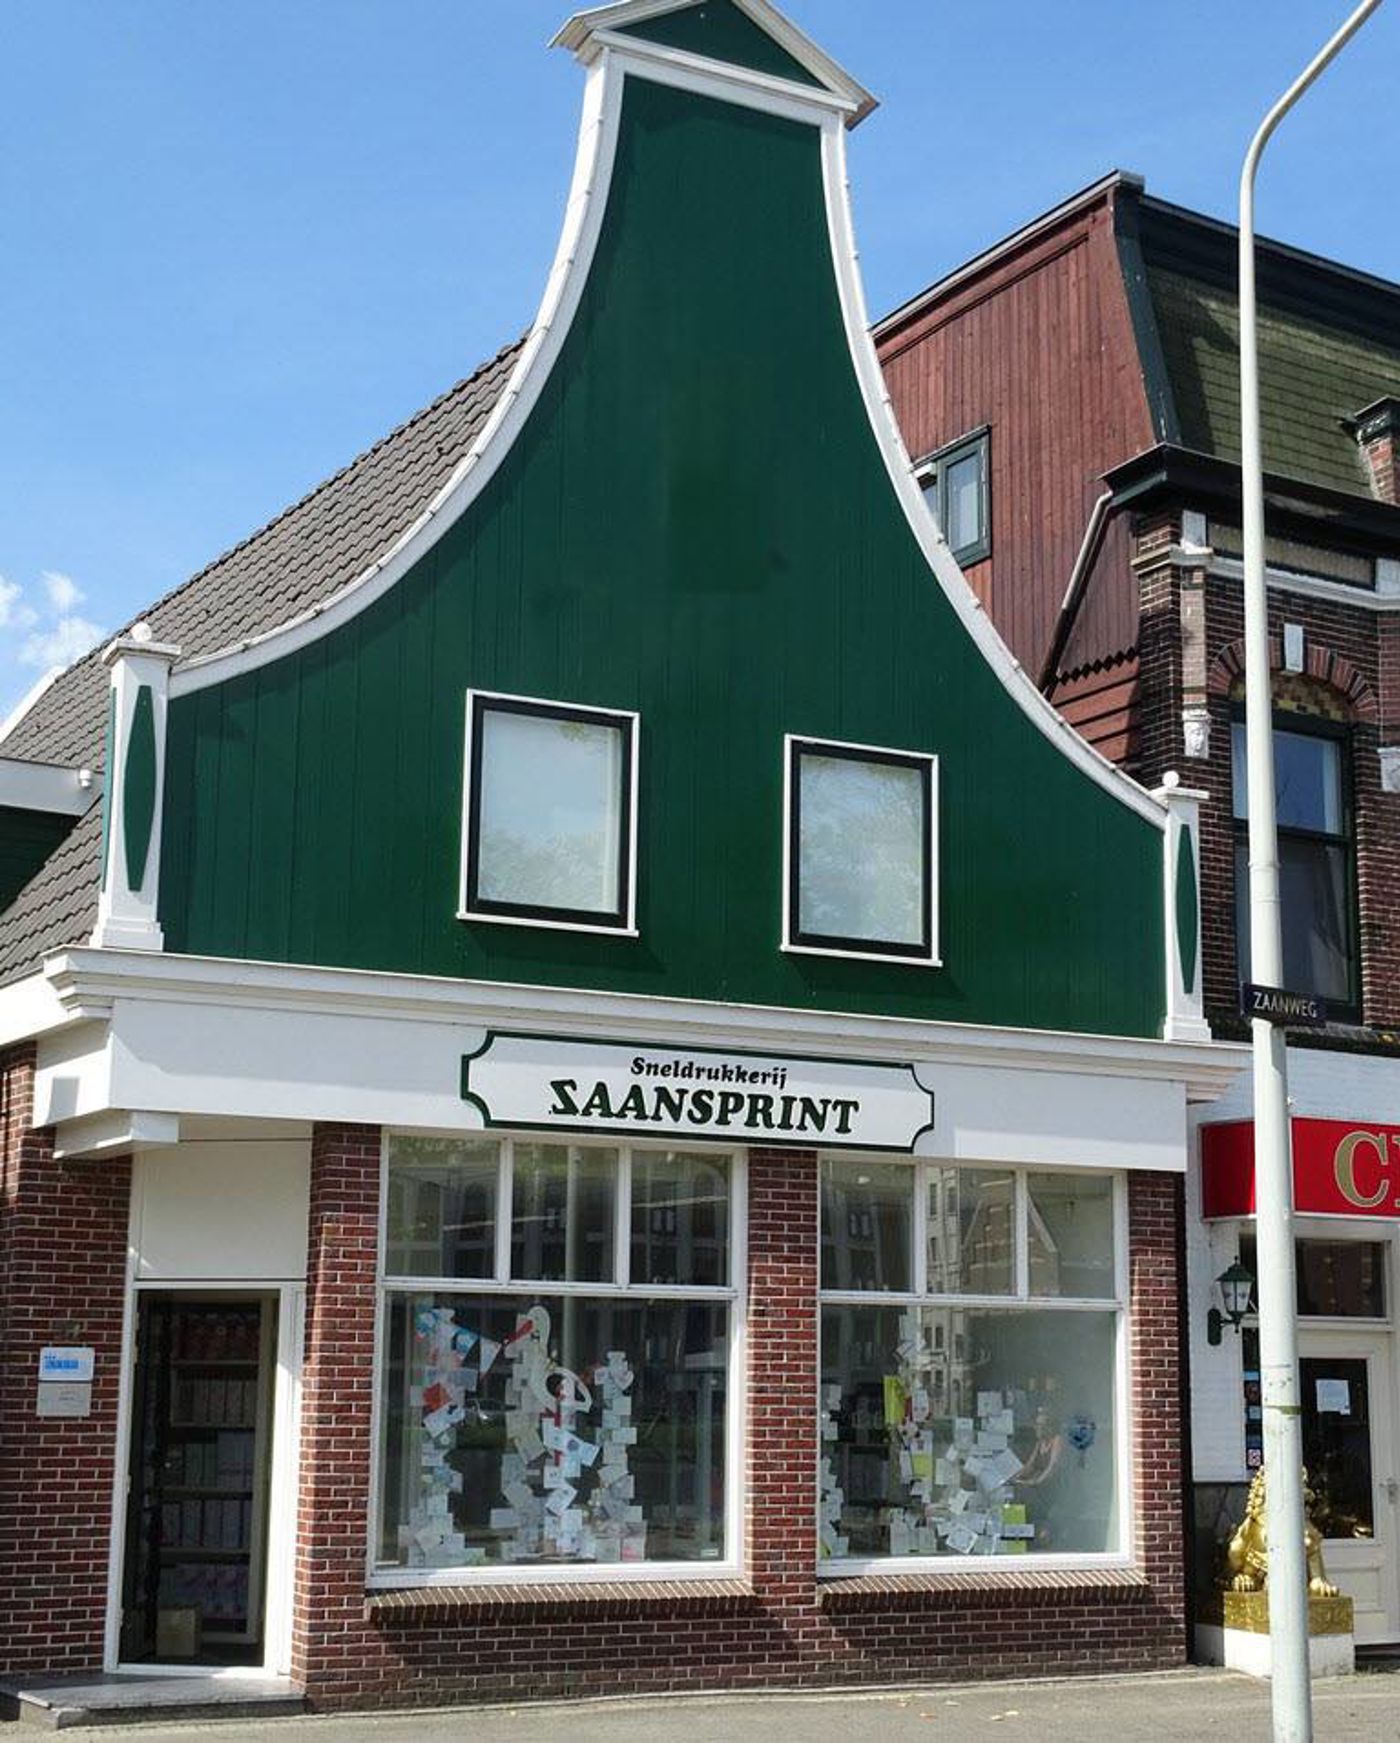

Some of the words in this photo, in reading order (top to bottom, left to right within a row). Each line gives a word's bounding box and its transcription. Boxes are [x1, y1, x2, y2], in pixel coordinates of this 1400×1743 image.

[1253, 991, 1318, 1018] ZAANWEG
[630, 1056, 788, 1090] Sneldrukkerij
[1334, 1130, 1400, 1208] C
